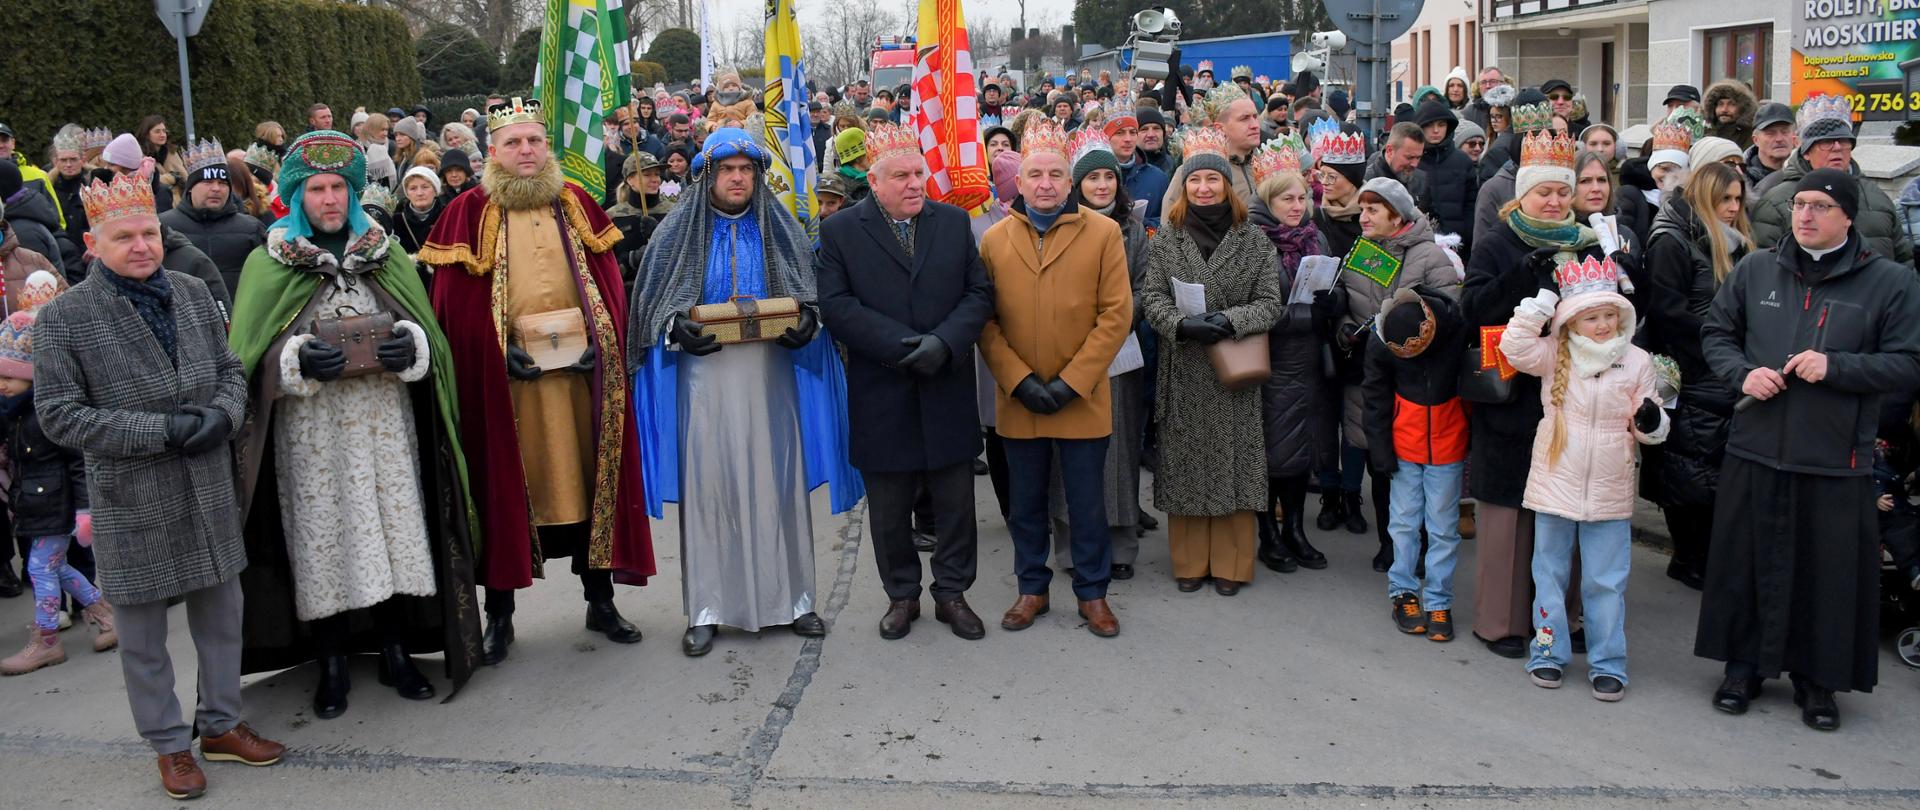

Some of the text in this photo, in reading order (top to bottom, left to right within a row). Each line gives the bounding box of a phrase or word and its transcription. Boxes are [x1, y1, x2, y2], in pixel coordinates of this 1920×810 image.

[1804, 0, 1883, 19] ROLETY,
[1804, 51, 1895, 66] Dąbrowa Tarnowska
[1804, 66, 1869, 79] ul. Zazamcze 51
[1844, 94, 1866, 112] 02
[1870, 92, 1905, 111] 756
[203, 168, 227, 179] NYC
